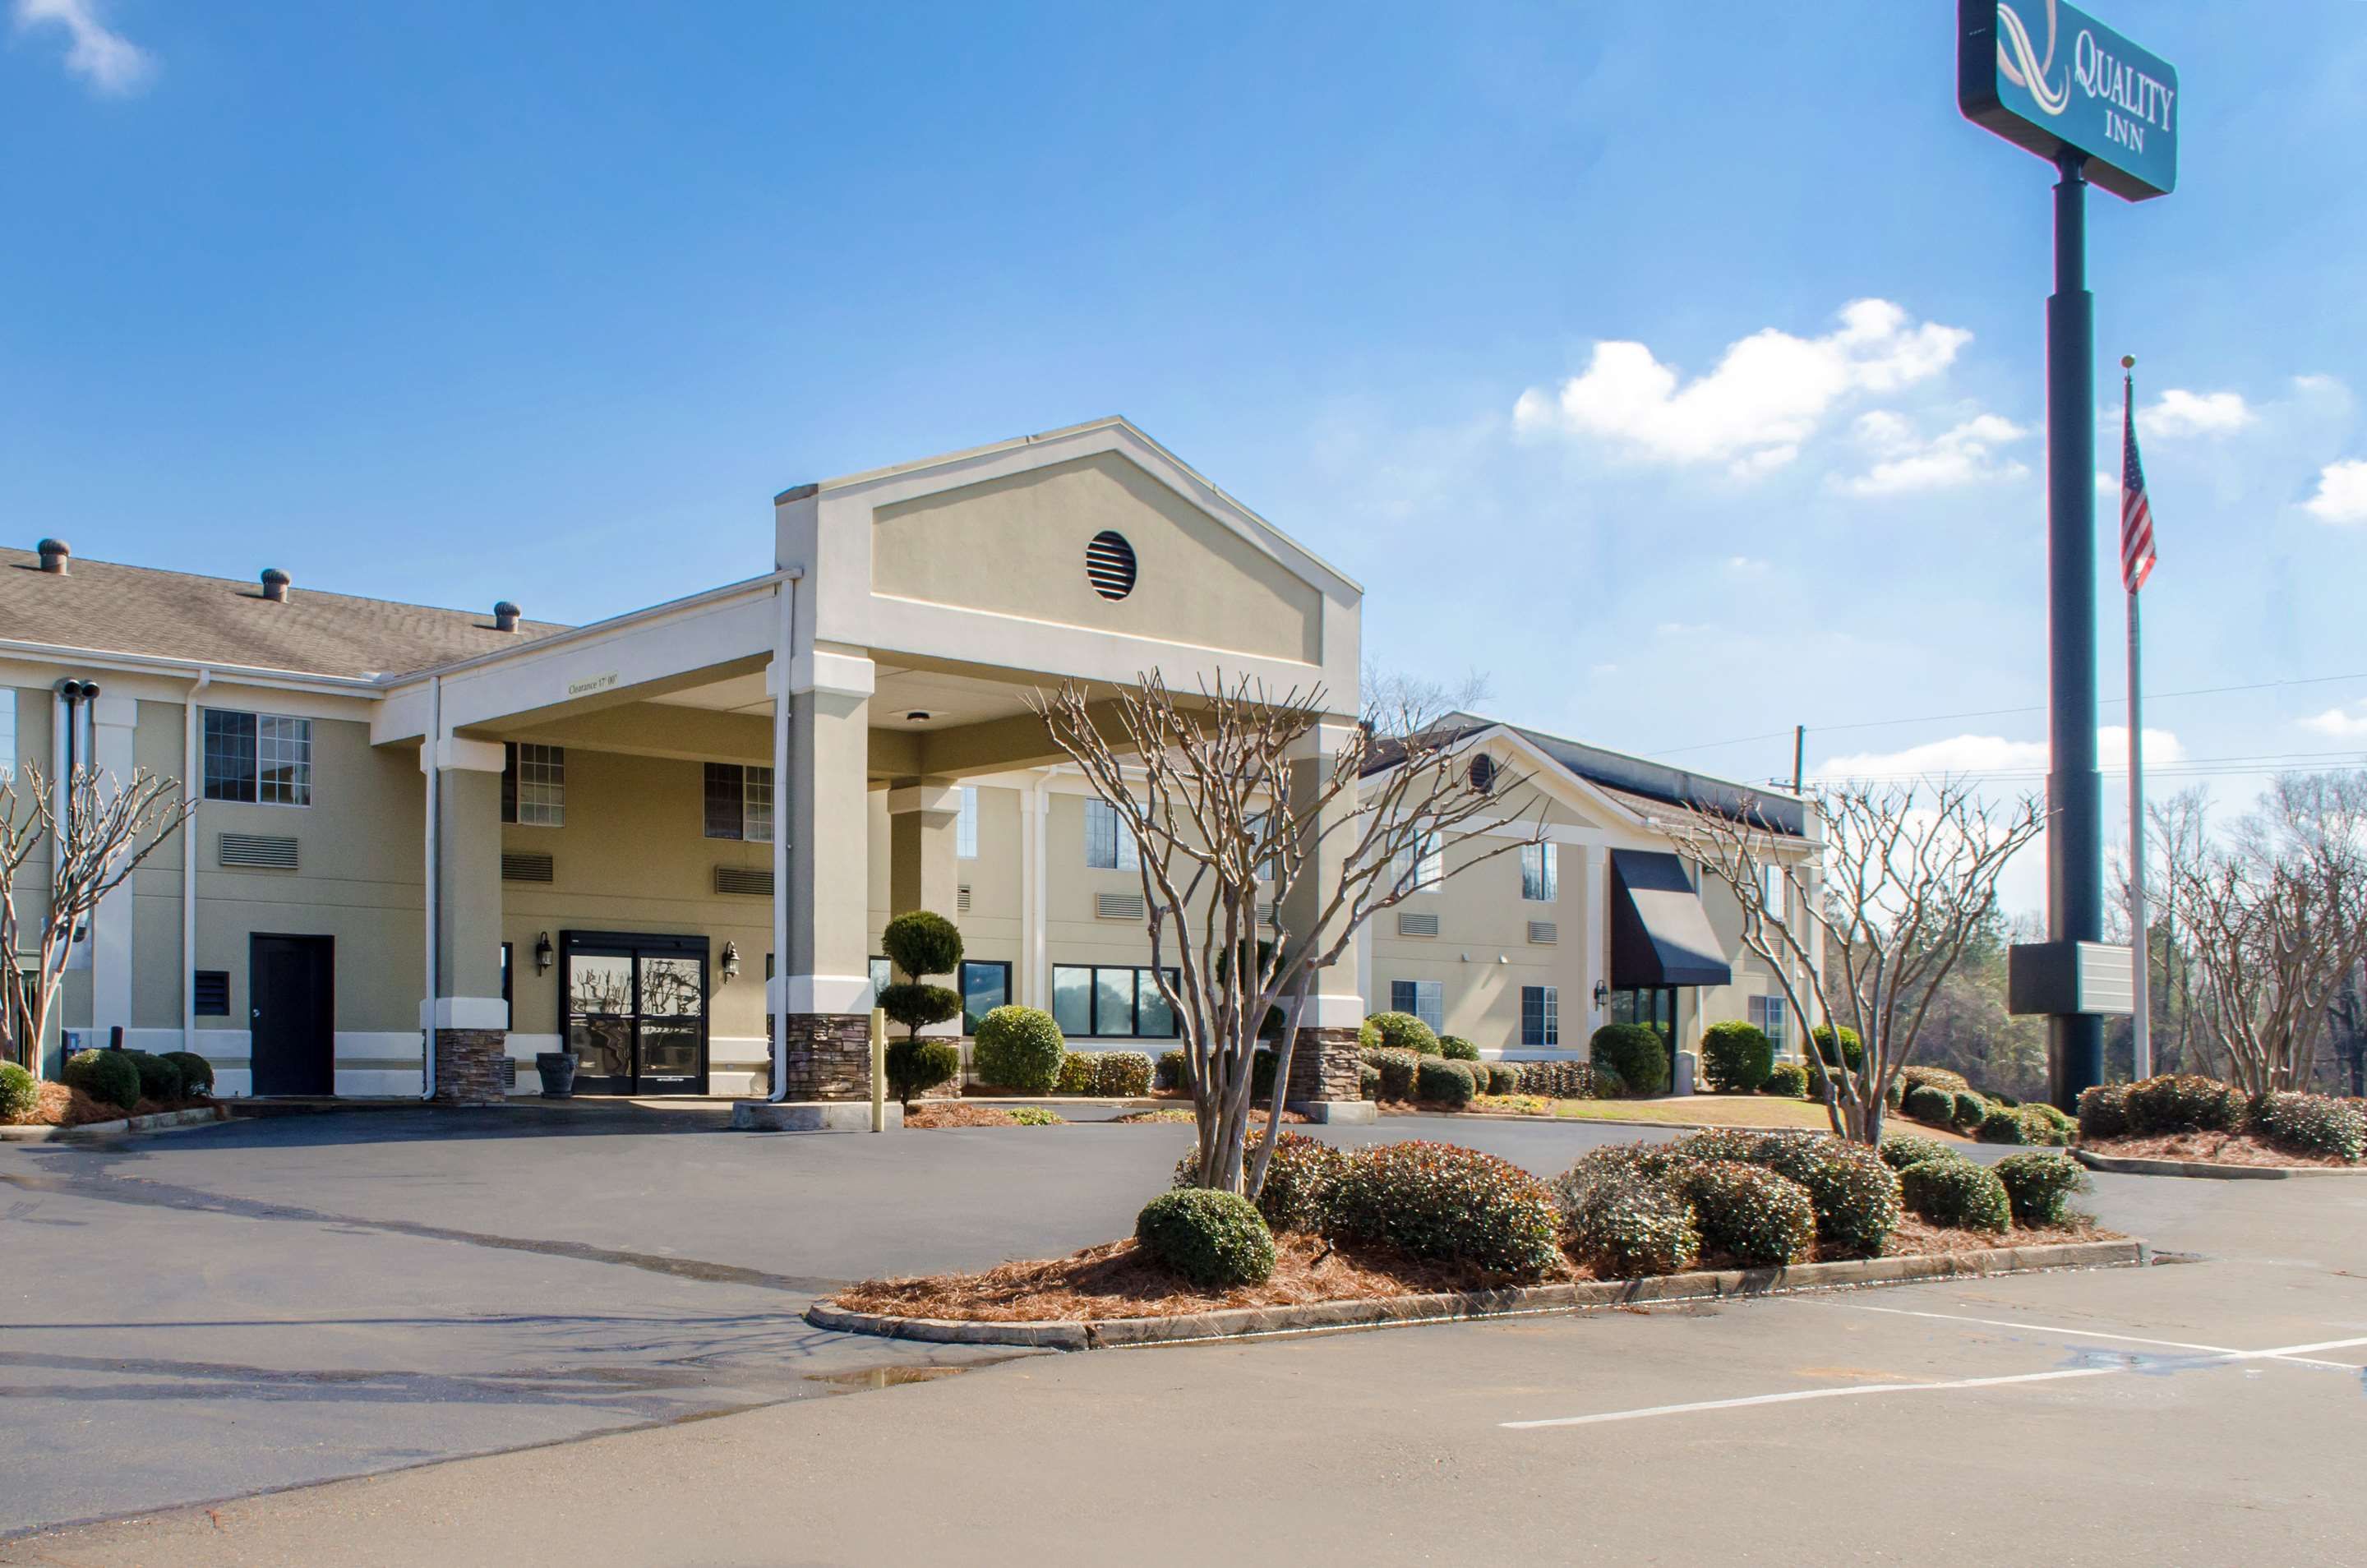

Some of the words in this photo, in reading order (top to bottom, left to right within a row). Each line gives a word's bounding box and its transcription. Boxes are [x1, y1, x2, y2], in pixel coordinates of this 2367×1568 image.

[2075, 30, 2174, 131] QUALITY
[2105, 109, 2144, 154] INN
[569, 682, 598, 694] Clearance
